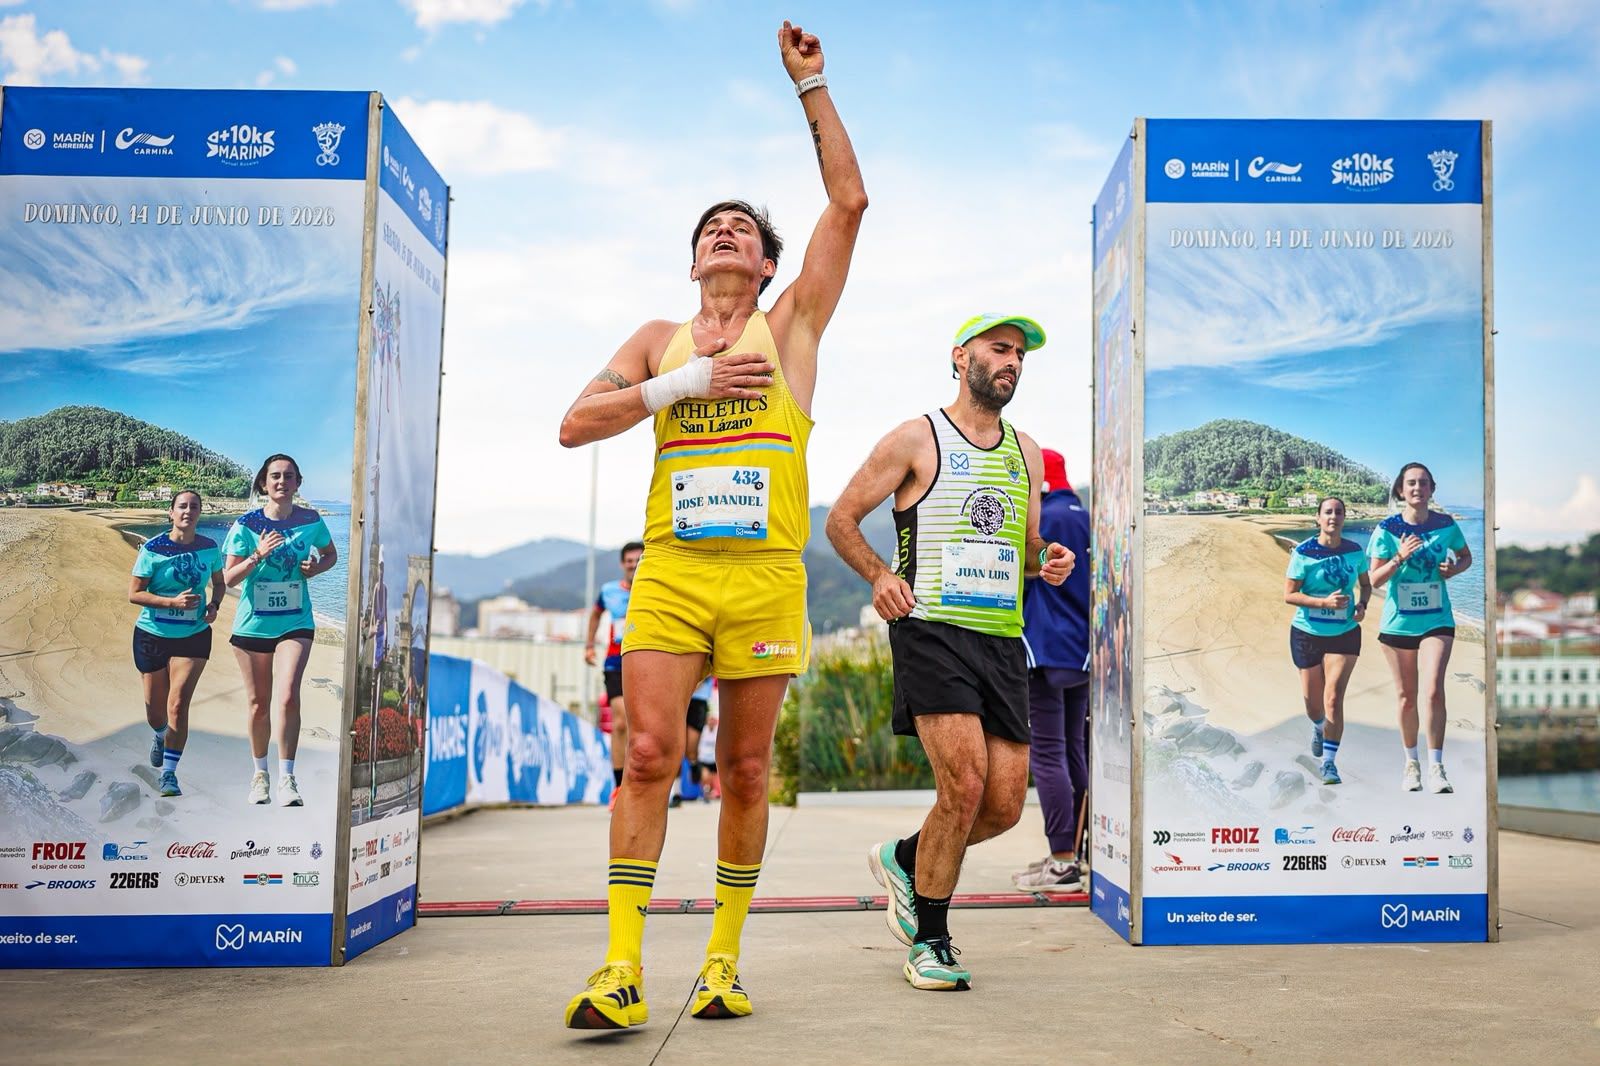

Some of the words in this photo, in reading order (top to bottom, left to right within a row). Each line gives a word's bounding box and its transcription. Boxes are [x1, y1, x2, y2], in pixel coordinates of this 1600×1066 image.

[53, 131, 94, 143] MARÍN
[1191, 161, 1229, 172] MARÍN
[1265, 175, 1302, 183] CARMIÑA
[24, 203, 122, 227] DOMINGO,
[129, 204, 149, 224] 14
[156, 204, 183, 225] DE
[189, 205, 250, 226] JUNIO
[258, 206, 283, 227] DE
[290, 206, 335, 227] 2026
[1170, 229, 1258, 250] DOMINGO,
[1265, 229, 1282, 249] 14
[1289, 229, 1313, 249] DE
[1320, 230, 1375, 249] JUNIO
[1382, 230, 1406, 249] DE
[1412, 230, 1454, 249] 2026
[671, 394, 767, 420] ATHLETICS
[681, 420, 704, 433] San
[709, 417, 752, 433] Lázaro
[732, 470, 760, 485] 432
[676, 497, 704, 511] JOSE
[708, 495, 763, 507] MANUEL
[998, 548, 1014, 562] 381
[956, 567, 985, 578] JUAN
[989, 570, 1010, 581] LUIS
[268, 596, 287, 607] 513
[1411, 596, 1428, 607] 513
[1212, 828, 1260, 844] FROIZ
[1390, 831, 1426, 844] Dromedario
[32, 842, 87, 860] FROIZ
[231, 847, 269, 860] Dromedario
[1227, 862, 1270, 871] BROOKS
[1283, 855, 1327, 870] 226ERS
[1355, 858, 1387, 866] DEVESA
[47, 880, 96, 889] BROOKS
[110, 872, 159, 889] 226ERS
[190, 873, 225, 884] DEVESA
[1167, 912, 1184, 923] Un
[1187, 911, 1217, 923] xeito
[1218, 911, 1234, 922] de
[1236, 913, 1257, 922] ser.
[1411, 907, 1460, 922] MARÍN
[0, 932, 32, 944] xeito
[35, 932, 52, 944] de
[54, 934, 78, 944] ser.
[248, 927, 302, 943] MARÍN
